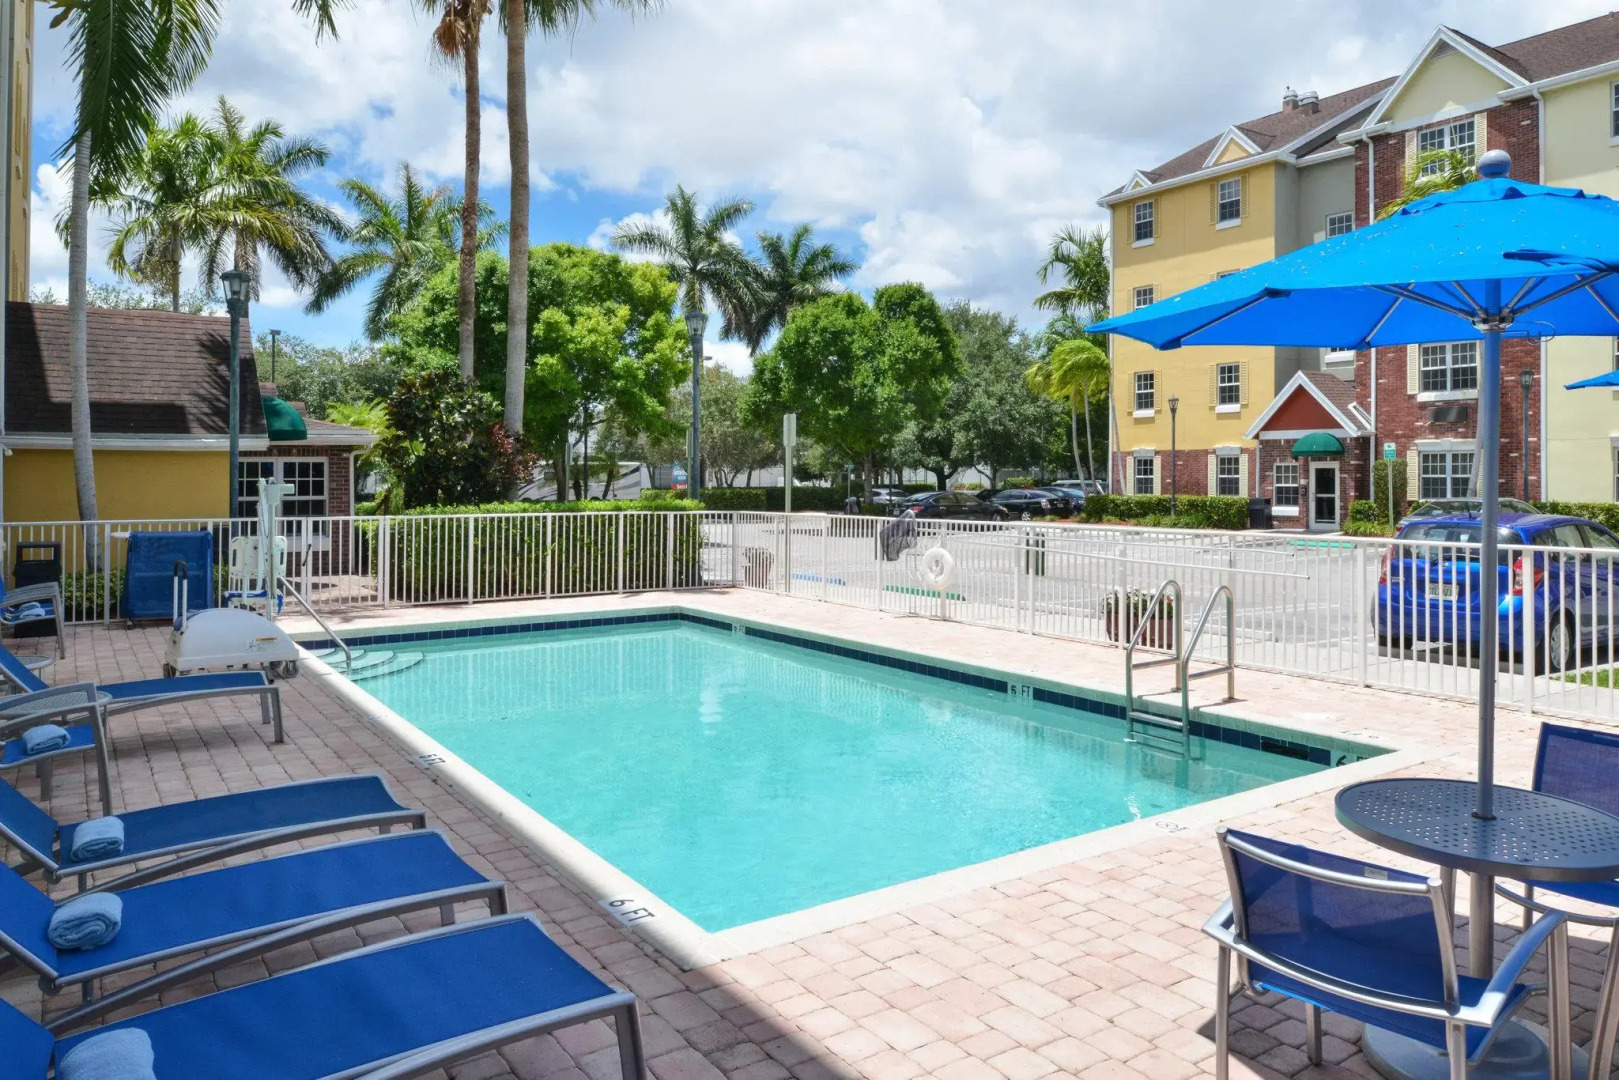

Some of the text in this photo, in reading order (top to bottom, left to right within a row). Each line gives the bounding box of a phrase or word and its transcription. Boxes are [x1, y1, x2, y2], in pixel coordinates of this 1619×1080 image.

[1011, 684, 1031, 698] 5 FT
[423, 757, 447, 766] FT
[1335, 754, 1347, 767] 6
[608, 899, 656, 922] 6 FT
